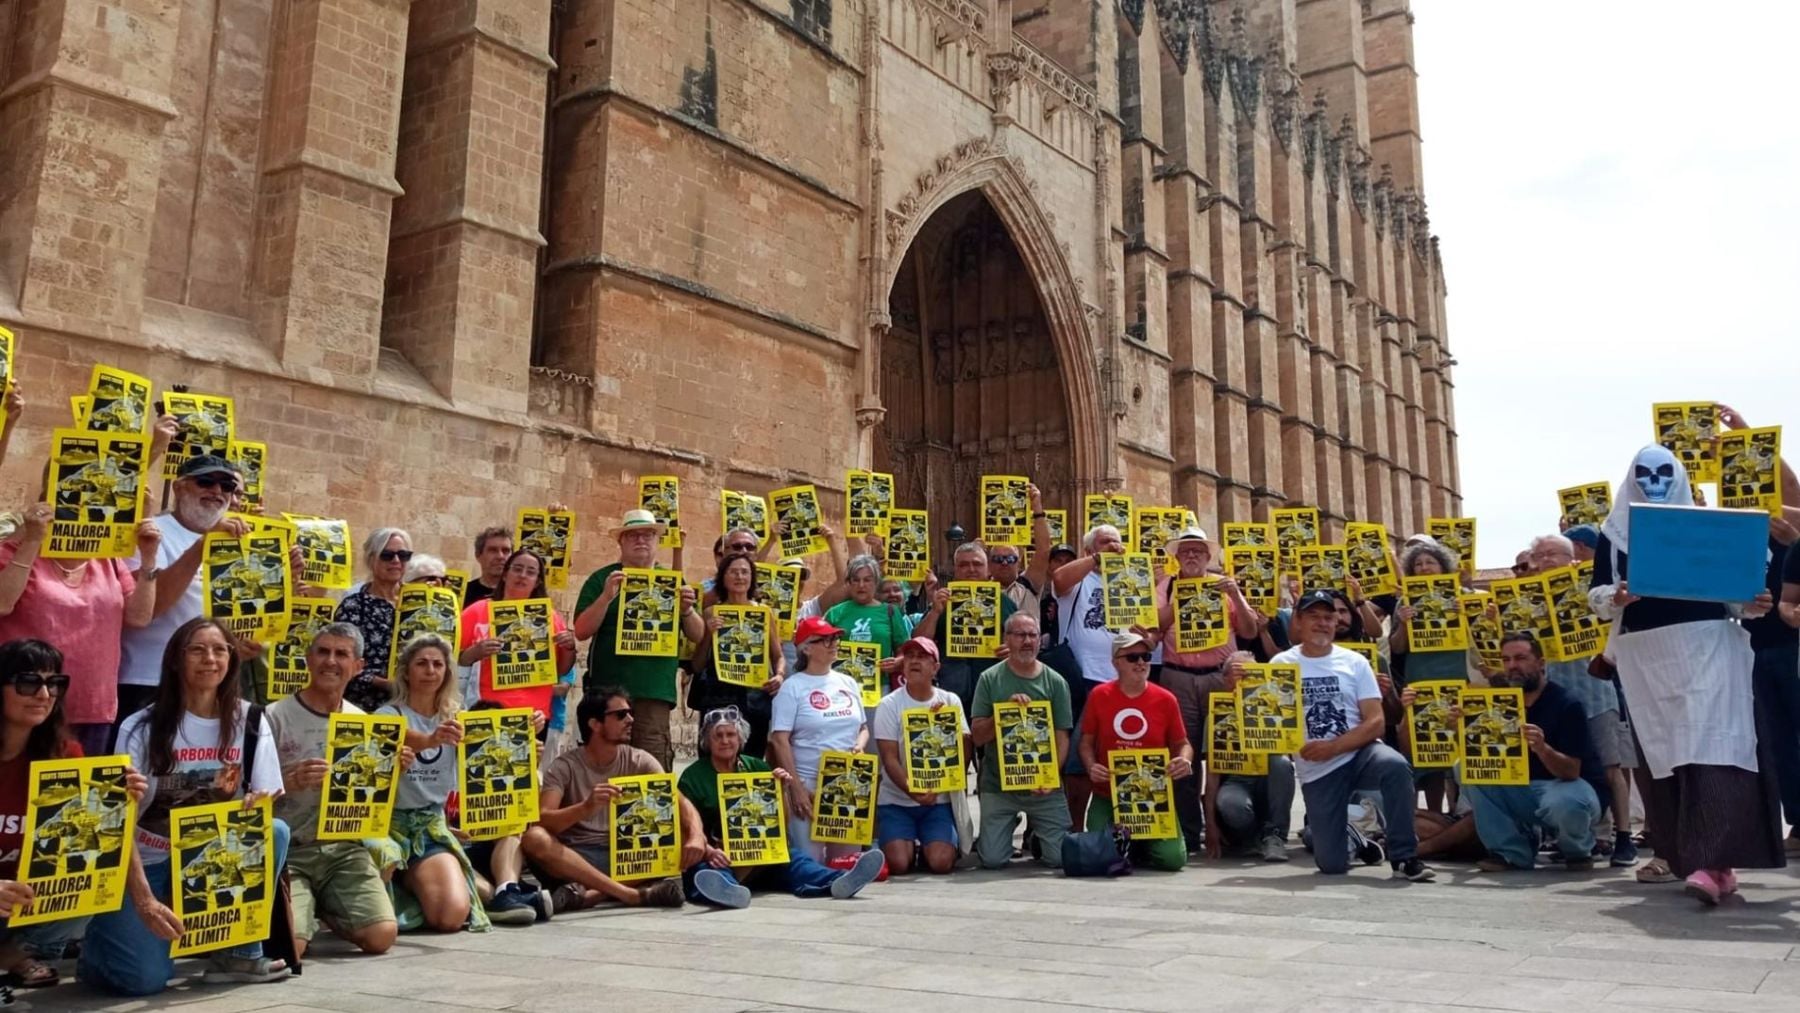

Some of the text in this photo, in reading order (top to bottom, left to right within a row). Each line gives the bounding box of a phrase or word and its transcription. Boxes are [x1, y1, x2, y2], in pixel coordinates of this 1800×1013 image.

[52, 523, 111, 538] MALLORCA
[50, 538, 62, 552] AL
[304, 560, 330, 573] LLORCA
[622, 631, 658, 642] MALLORCA
[1561, 628, 1600, 645] MALLORCA
[497, 663, 535, 675] MALLORCA
[273, 671, 309, 682] MALLORCA
[1244, 728, 1281, 739] MALLORCA
[1416, 743, 1455, 752] MALLORCA
[1213, 752, 1248, 762] MALLORCA
[1466, 759, 1506, 768] MALLORCA
[912, 768, 945, 778] MALLORCA
[1005, 765, 1039, 776] MALLORCA
[1466, 769, 1476, 780] AL
[466, 794, 513, 809] MALLORCA
[326, 805, 370, 818] MALLORCA
[466, 812, 476, 824] AL
[324, 820, 334, 832] AL
[729, 840, 766, 851] MALLORCA
[616, 850, 658, 863] MALLORCA
[730, 851, 739, 861] AL
[616, 864, 626, 875] AL
[27, 874, 92, 897] MALLORCA
[183, 908, 240, 932] MALLORCA
[179, 934, 192, 948] AL
